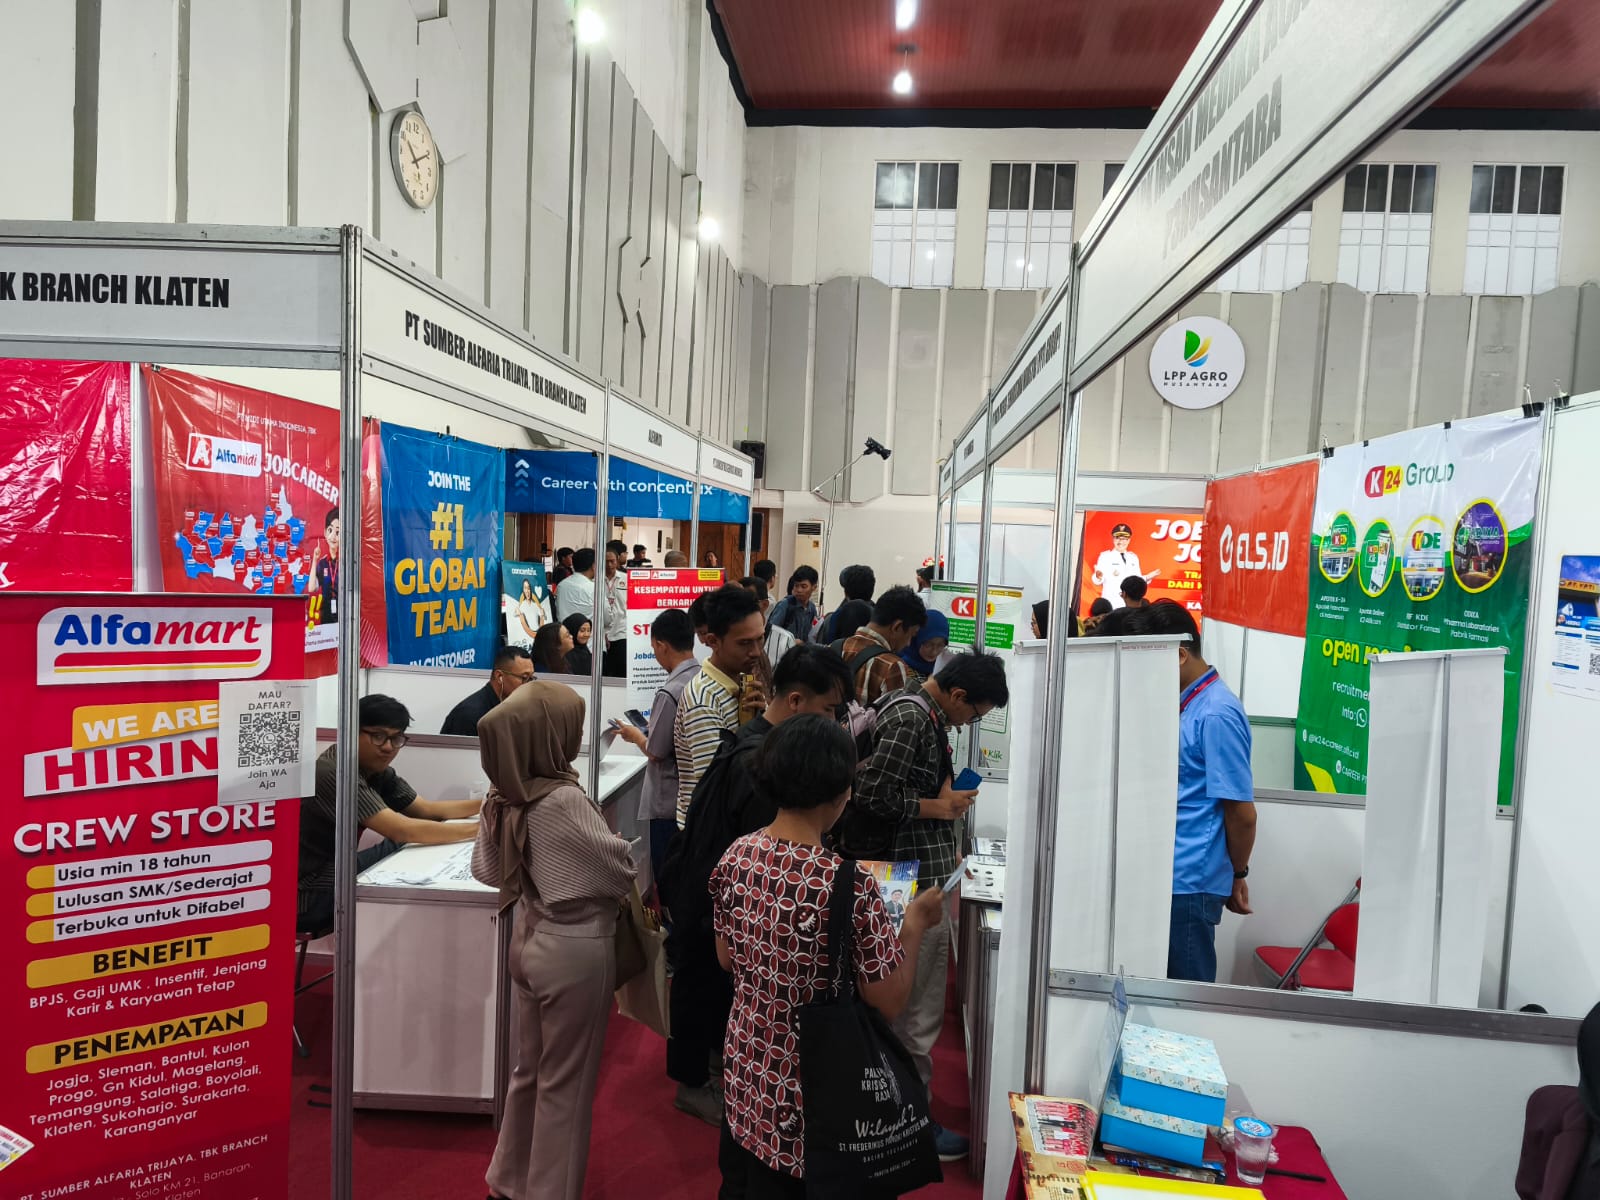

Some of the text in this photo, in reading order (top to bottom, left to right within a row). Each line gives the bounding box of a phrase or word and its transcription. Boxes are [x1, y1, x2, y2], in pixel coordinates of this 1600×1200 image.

[22, 272, 128, 304] BRANCH
[134, 275, 230, 308] KLATEN
[405, 310, 420, 341] PT
[423, 319, 466, 362] SUMBER
[467, 341, 501, 377] ALFARIA
[531, 372, 543, 396] TBK
[544, 378, 567, 406] BRANCH
[568, 389, 587, 415] KLATEN
[1164, 371, 1228, 381] LPP AGRO
[216, 448, 258, 467] Alfamidi
[428, 470, 471, 492] JOIN THE
[541, 477, 590, 490] Career
[629, 480, 713, 495] concentix
[430, 502, 464, 550] #1
[1237, 531, 1289, 571] ELS.ID
[1411, 530, 1441, 551] KDE
[634, 585, 690, 594] KESEMPATAN
[1168, 580, 1194, 589] DARI
[54, 613, 262, 646] Alfamart
[411, 597, 477, 638] TEAM
[423, 648, 475, 668] CUSTOMER
[1322, 638, 1360, 666] open
[258, 690, 282, 699] MAU
[1332, 681, 1369, 700] recruitme
[248, 700, 292, 711] DAFTAR?
[82, 702, 219, 743] WE ARE
[44, 737, 218, 791] HIRIN
[247, 768, 288, 779] Join WA
[258, 779, 276, 790] Aja
[13, 801, 276, 854] CREW STORE
[57, 852, 211, 882] Usia min 18 tahun
[57, 871, 254, 909] Lulusan SMK/Sederajat
[56, 897, 245, 936] Terbuka untuk Difabel
[92, 936, 213, 975] BENEFIT
[73, 985, 105, 1001] Gaji
[109, 979, 142, 995] UMK
[213, 957, 267, 978] Jenjang
[66, 979, 236, 1018] Karir & Karyawan Tetap
[54, 1009, 245, 1065] PENEMPATAN
[212, 1038, 250, 1056] Kulon
[103, 1079, 125, 1094] Gn
[103, 1108, 198, 1140] Karanganyar
[908, 1103, 917, 1122] 2
[41, 1178, 91, 1200] SUMBER
[94, 1165, 144, 1186] ALFARIA
[199, 1146, 220, 1160] TBK
[222, 1133, 269, 1154] BRANCH
[129, 1170, 173, 1190] KLATEN
[163, 1180, 182, 1193] KM
